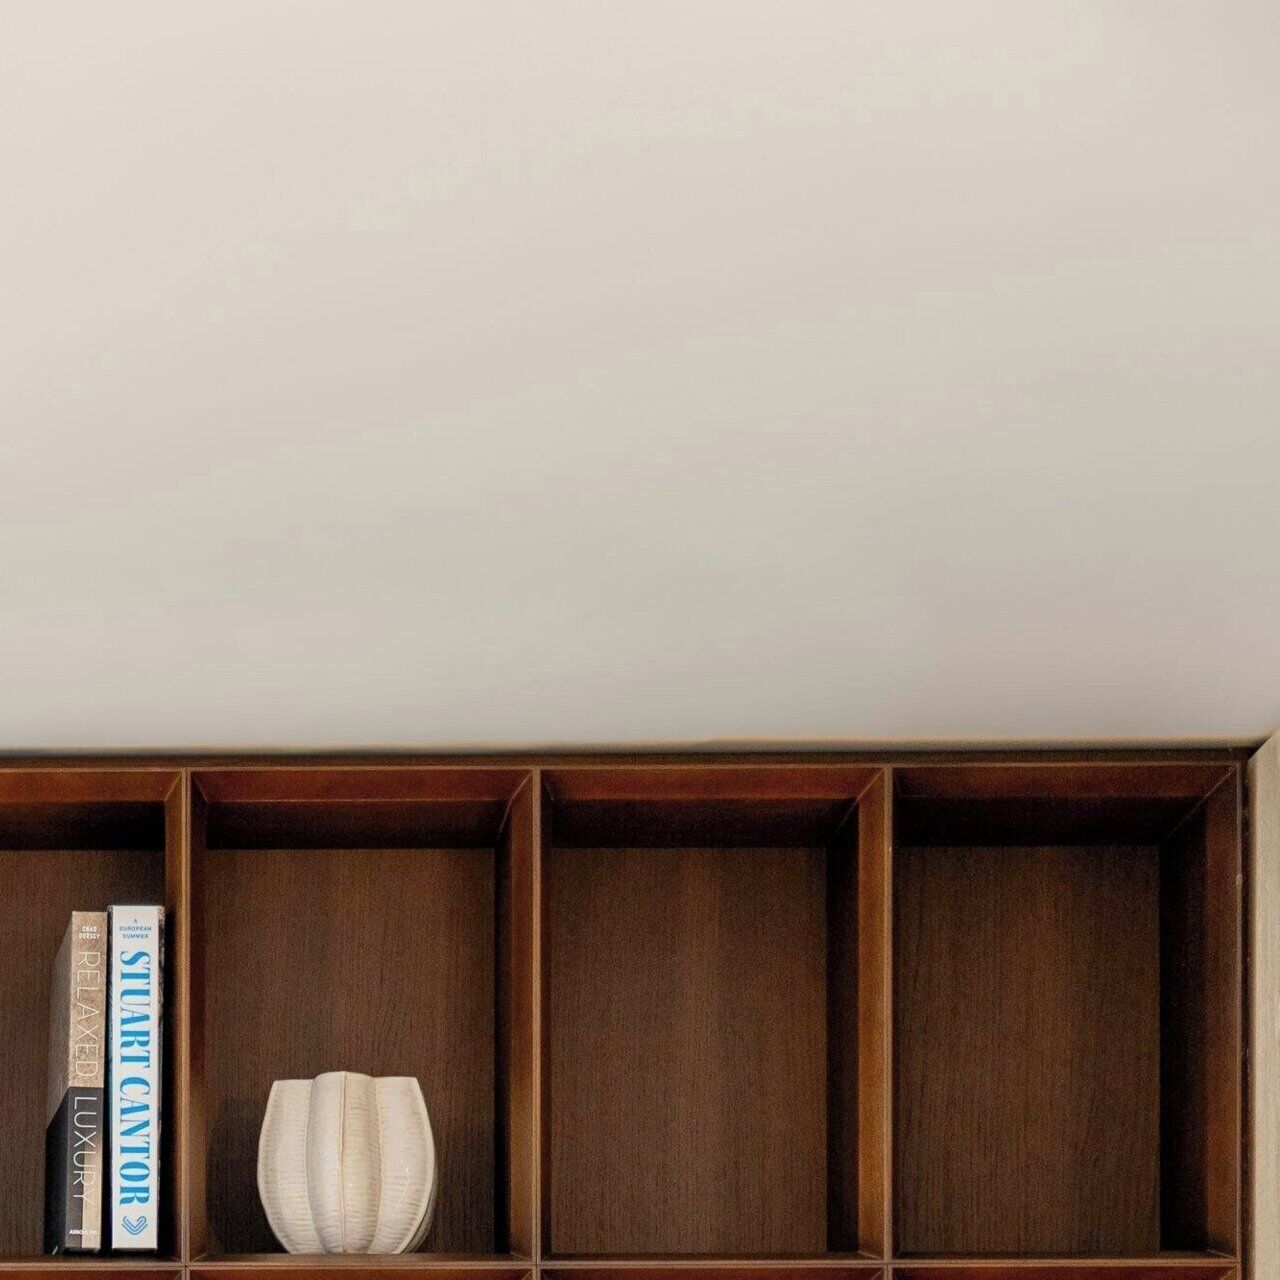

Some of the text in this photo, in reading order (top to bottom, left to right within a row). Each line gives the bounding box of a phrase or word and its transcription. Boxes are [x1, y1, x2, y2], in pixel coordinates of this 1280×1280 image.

[71, 951, 100, 1208] RELAXED LUXURY
[120, 951, 152, 1206] STUART CANTOR
